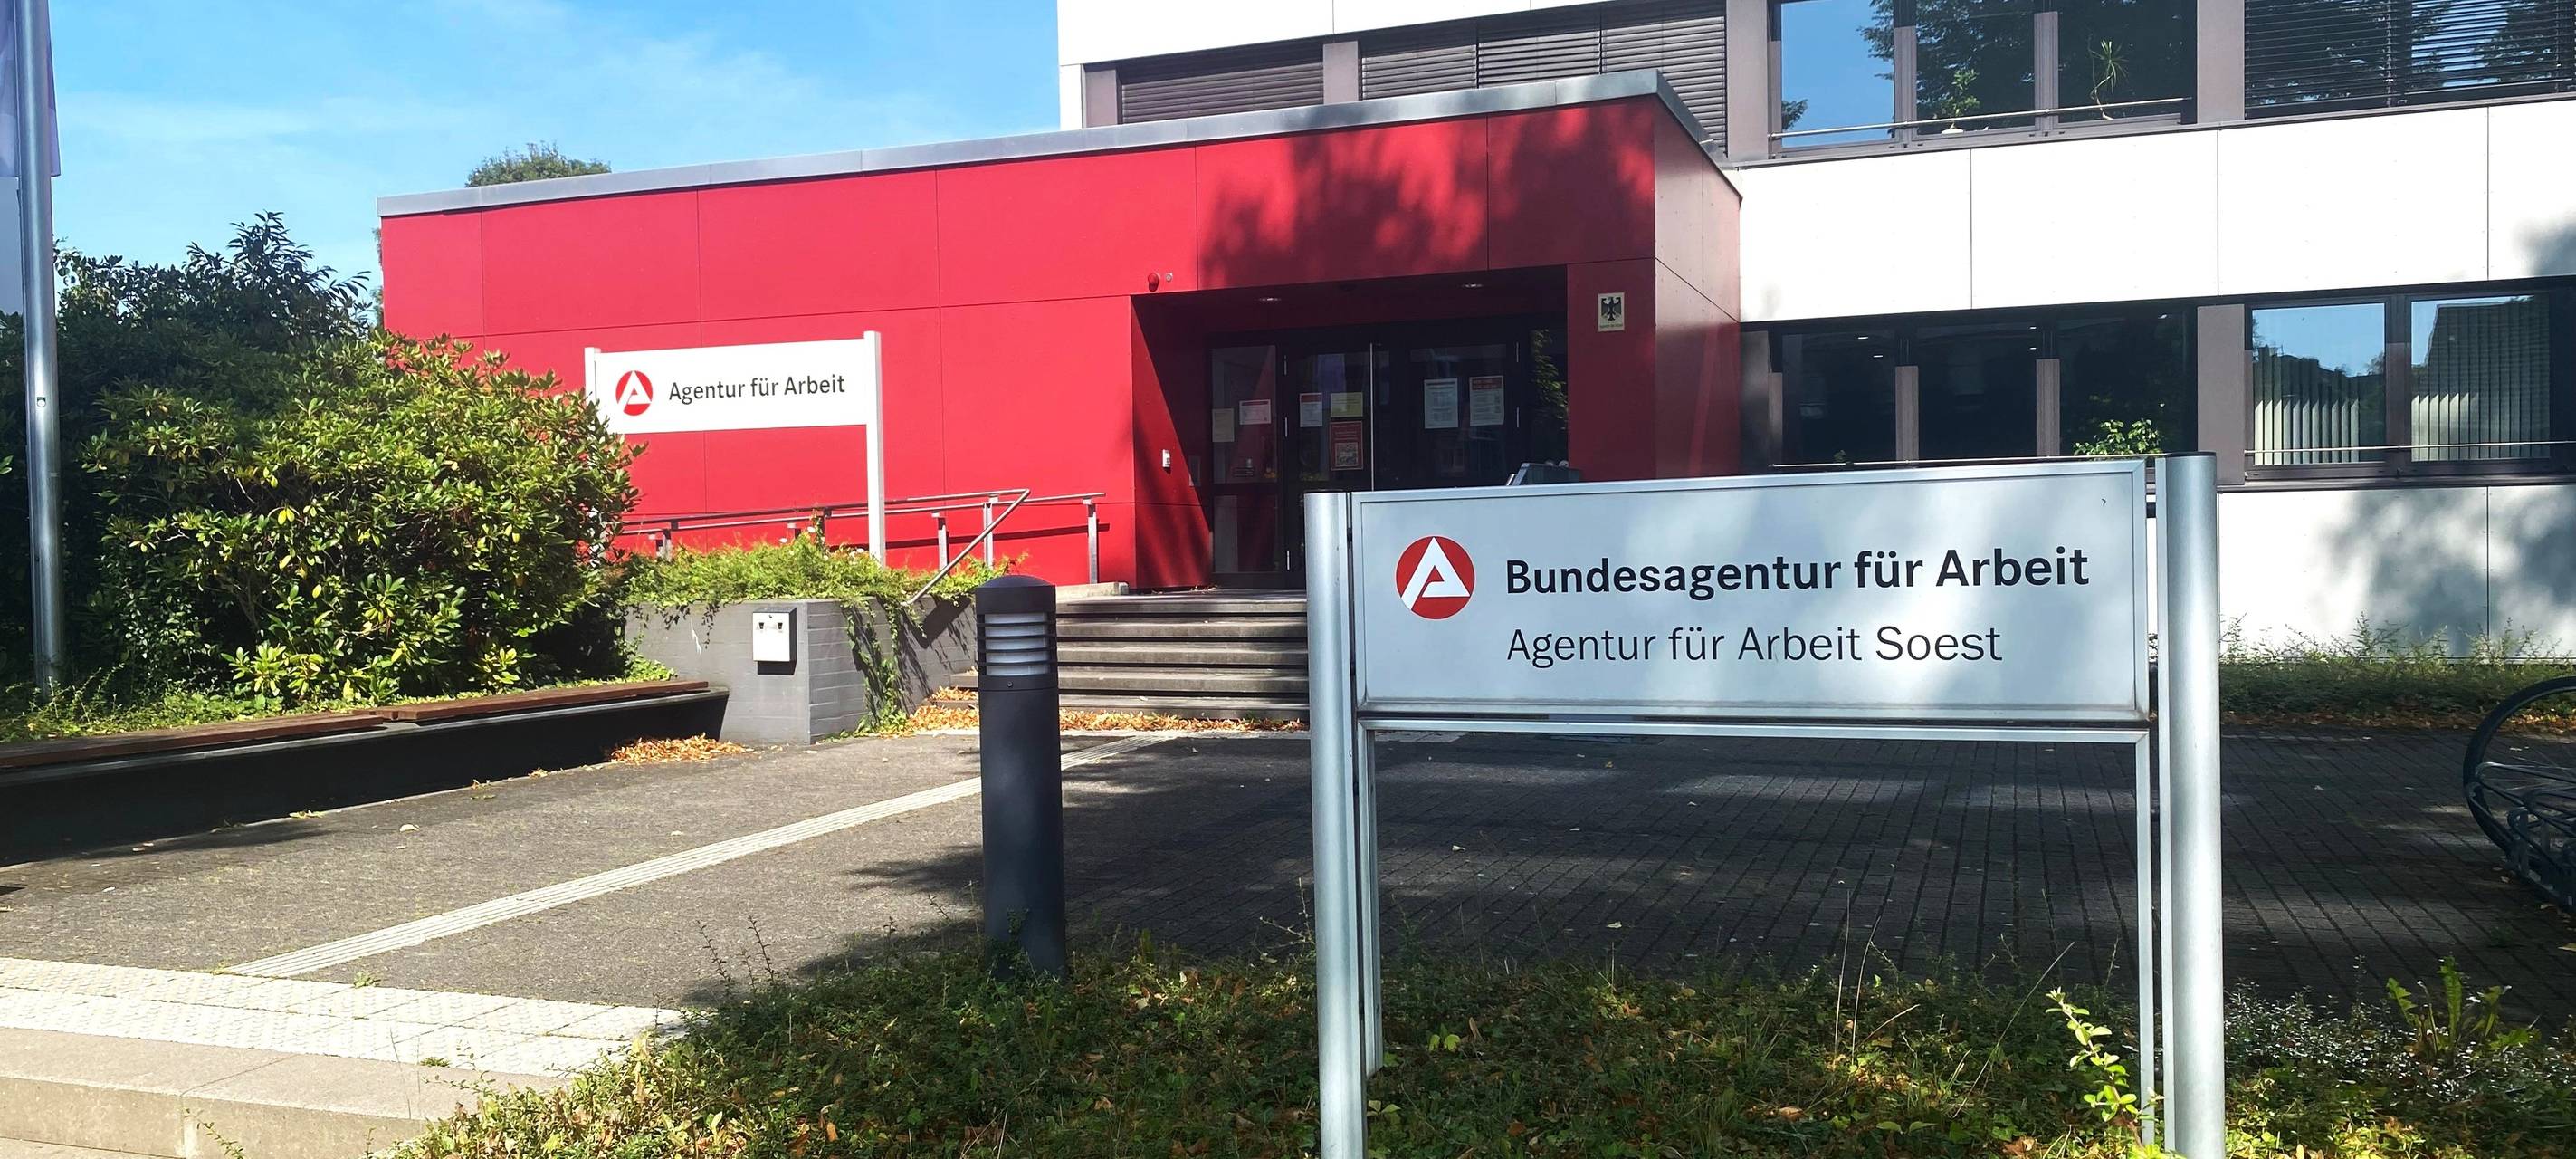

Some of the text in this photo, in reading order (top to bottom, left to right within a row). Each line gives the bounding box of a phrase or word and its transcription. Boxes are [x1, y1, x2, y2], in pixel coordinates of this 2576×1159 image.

[668, 374, 846, 406] Agentur für Arbeit
[1505, 545, 2090, 601] Bundesagentur für Arbeit
[1506, 626, 2004, 669] Agentur für Arbeit Soest
